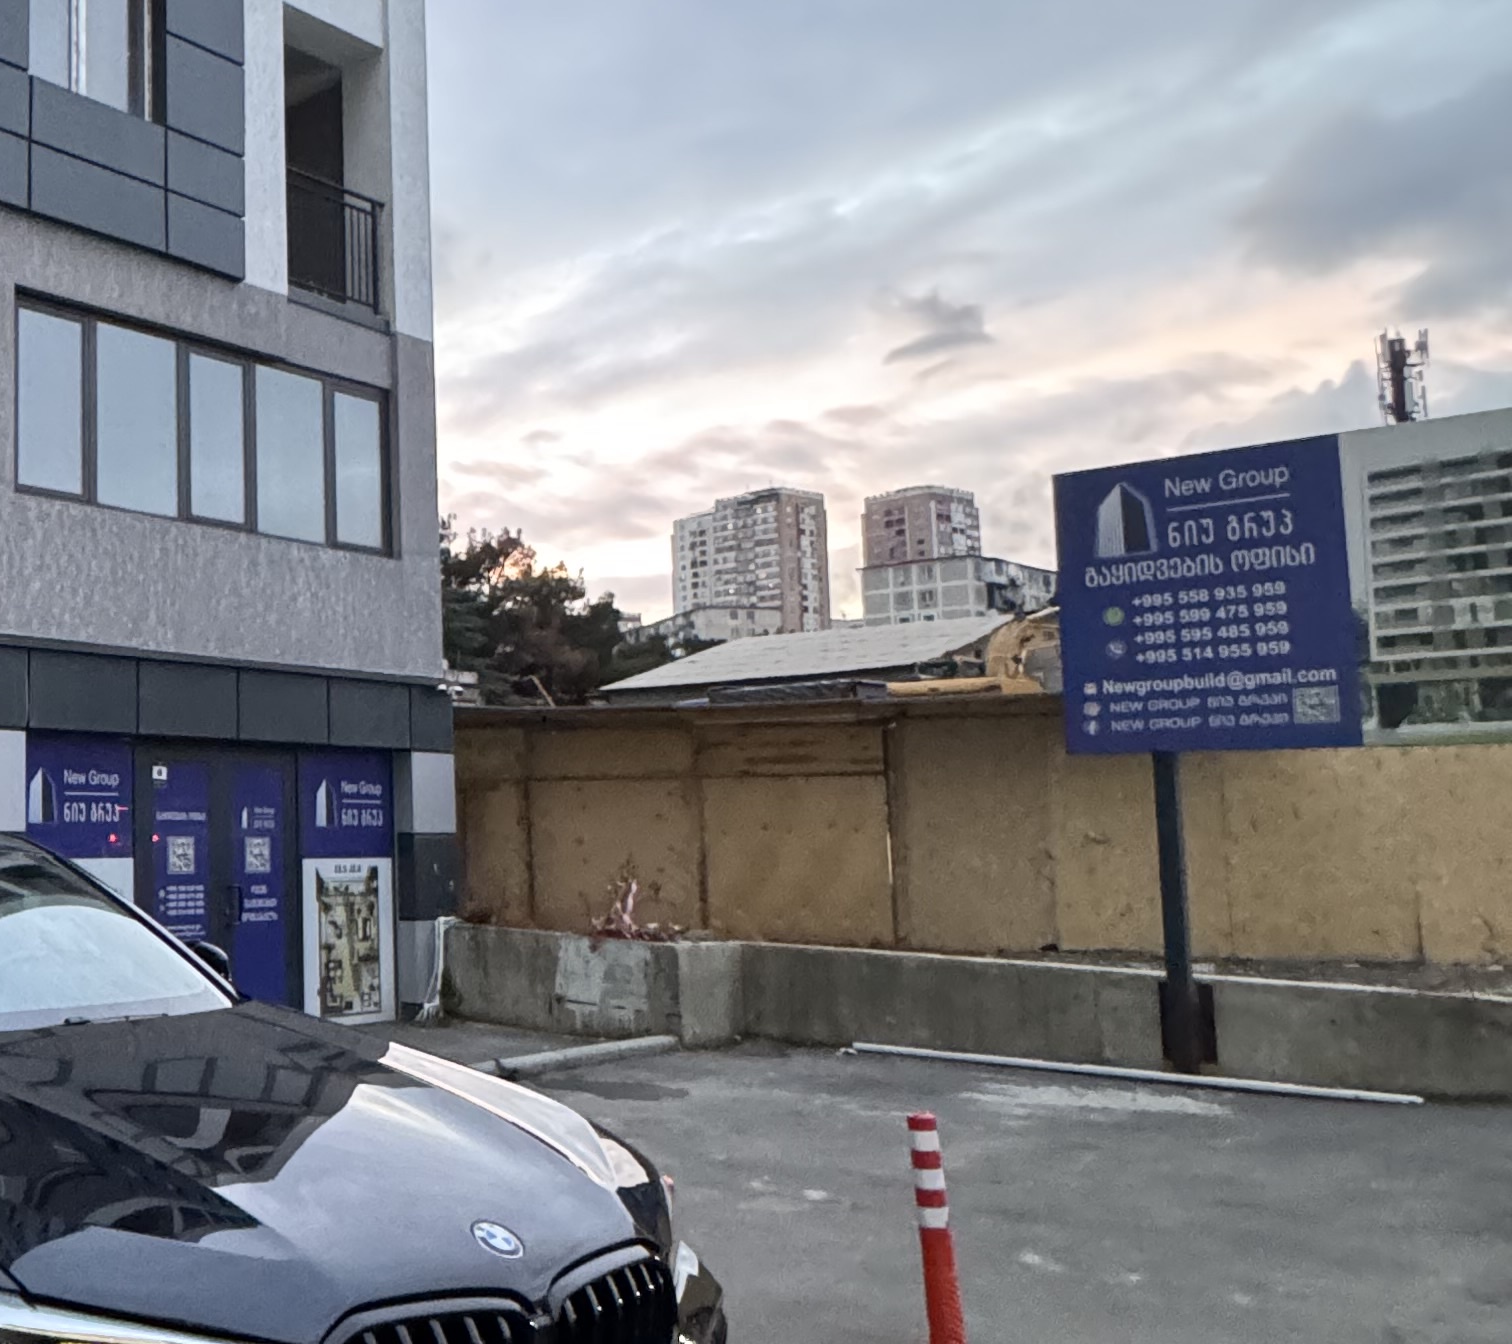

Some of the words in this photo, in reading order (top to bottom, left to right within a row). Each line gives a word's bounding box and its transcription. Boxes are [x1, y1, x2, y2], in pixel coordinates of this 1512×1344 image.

[1164, 476, 1213, 498] New
[1218, 464, 1290, 490] Group
[1167, 517, 1215, 548] ნიუ
[1226, 508, 1294, 541] გრუპ
[1085, 553, 1224, 588] გაყიდვების
[1230, 542, 1316, 572] ოფისი
[1131, 591, 1174, 608] +995
[1178, 588, 1210, 605] 558
[1132, 610, 1175, 627] +995
[1179, 607, 1211, 625] 599
[1215, 603, 1249, 620] 475
[1133, 629, 1177, 645] +995
[1216, 622, 1251, 639] 485
[1135, 648, 1178, 664] +995
[1181, 645, 1214, 661] 514
[1102, 667, 1337, 697] Newgroupbuild@gmail.com
[1109, 700, 1144, 713] NEW
[1147, 696, 1201, 711] GROUP
[1110, 719, 1145, 732] NEW
[1149, 716, 1202, 731] GROUP
[64, 768, 87, 786] New
[88, 768, 120, 788] Group
[340, 780, 358, 795] New
[359, 780, 383, 797] Group
